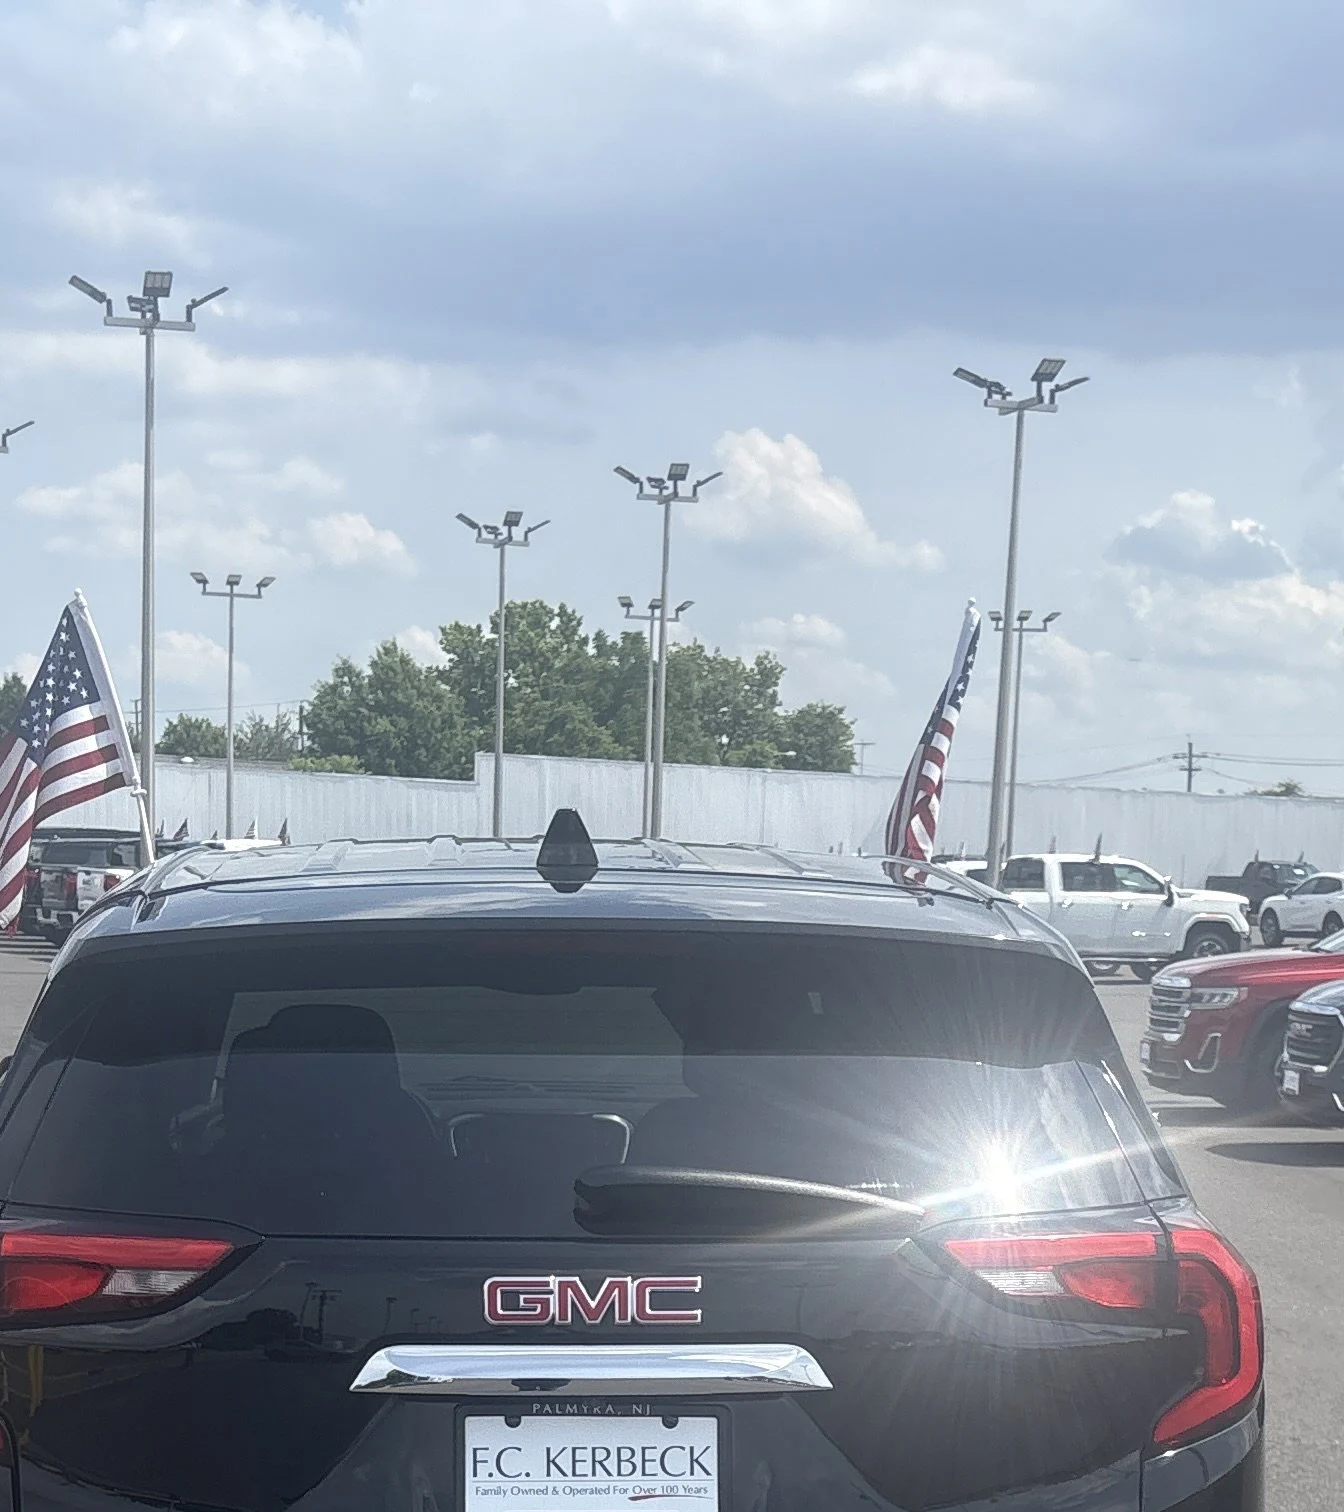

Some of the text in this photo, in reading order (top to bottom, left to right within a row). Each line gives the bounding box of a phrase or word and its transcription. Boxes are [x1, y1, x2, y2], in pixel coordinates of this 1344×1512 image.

[484, 1275, 702, 1325] GMC
[632, 1404, 652, 1415] NJ
[472, 1446, 713, 1478] F.C. KERBECK
[475, 1485, 708, 1498] Family Owned & Operated For Over 100 Years
